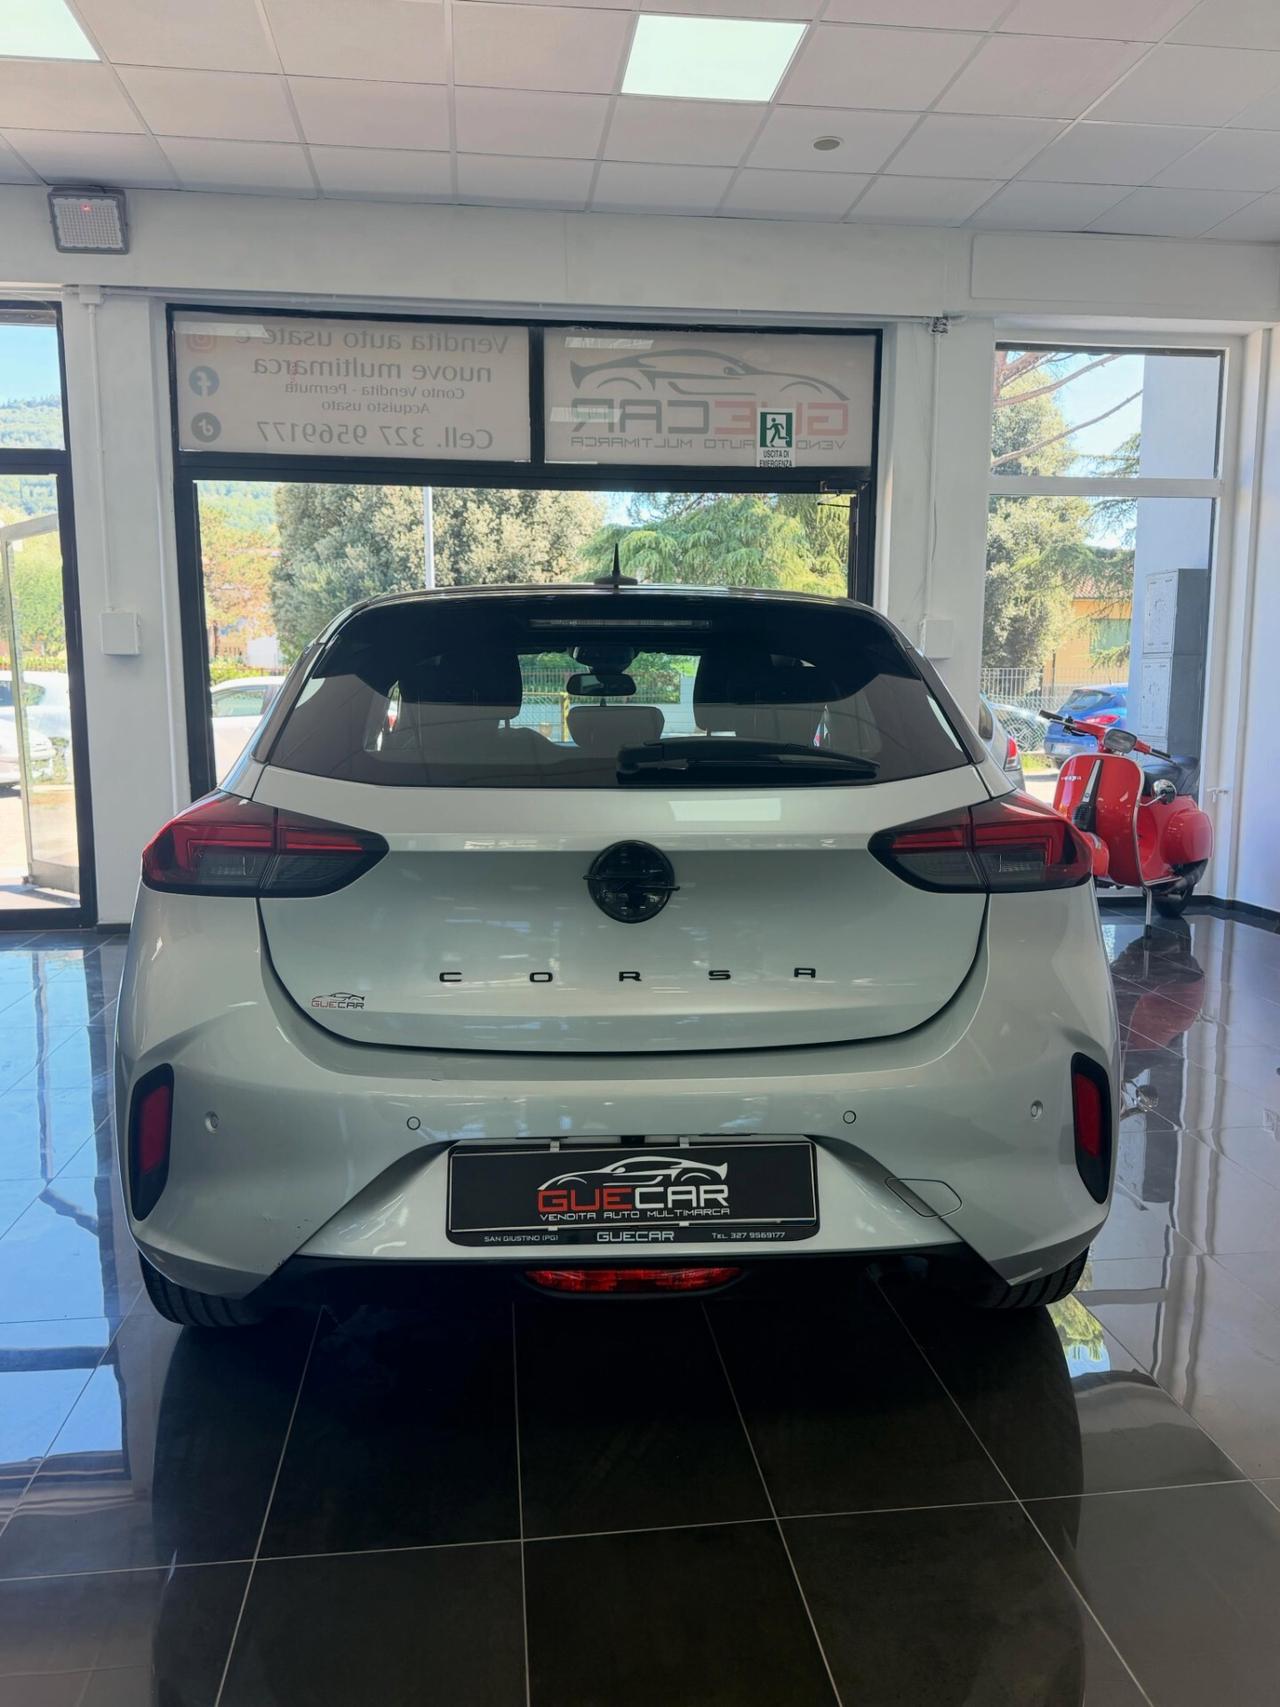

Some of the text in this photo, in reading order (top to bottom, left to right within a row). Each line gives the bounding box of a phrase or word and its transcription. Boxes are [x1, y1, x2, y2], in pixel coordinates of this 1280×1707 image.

[763, 449, 790, 458] USCITA DI
[438, 967, 817, 984] CORSA
[311, 1000, 365, 1009] GUECAR
[537, 1184, 730, 1213] GUECAR
[539, 1207, 731, 1222] VENDITA AUTO MULTIMARCA
[484, 1235, 501, 1243] SAN
[503, 1234, 540, 1242] GIUSTINO
[596, 1230, 675, 1242] GUECAR
[730, 1231, 747, 1239] 327
[749, 1231, 786, 1239] 9569177
